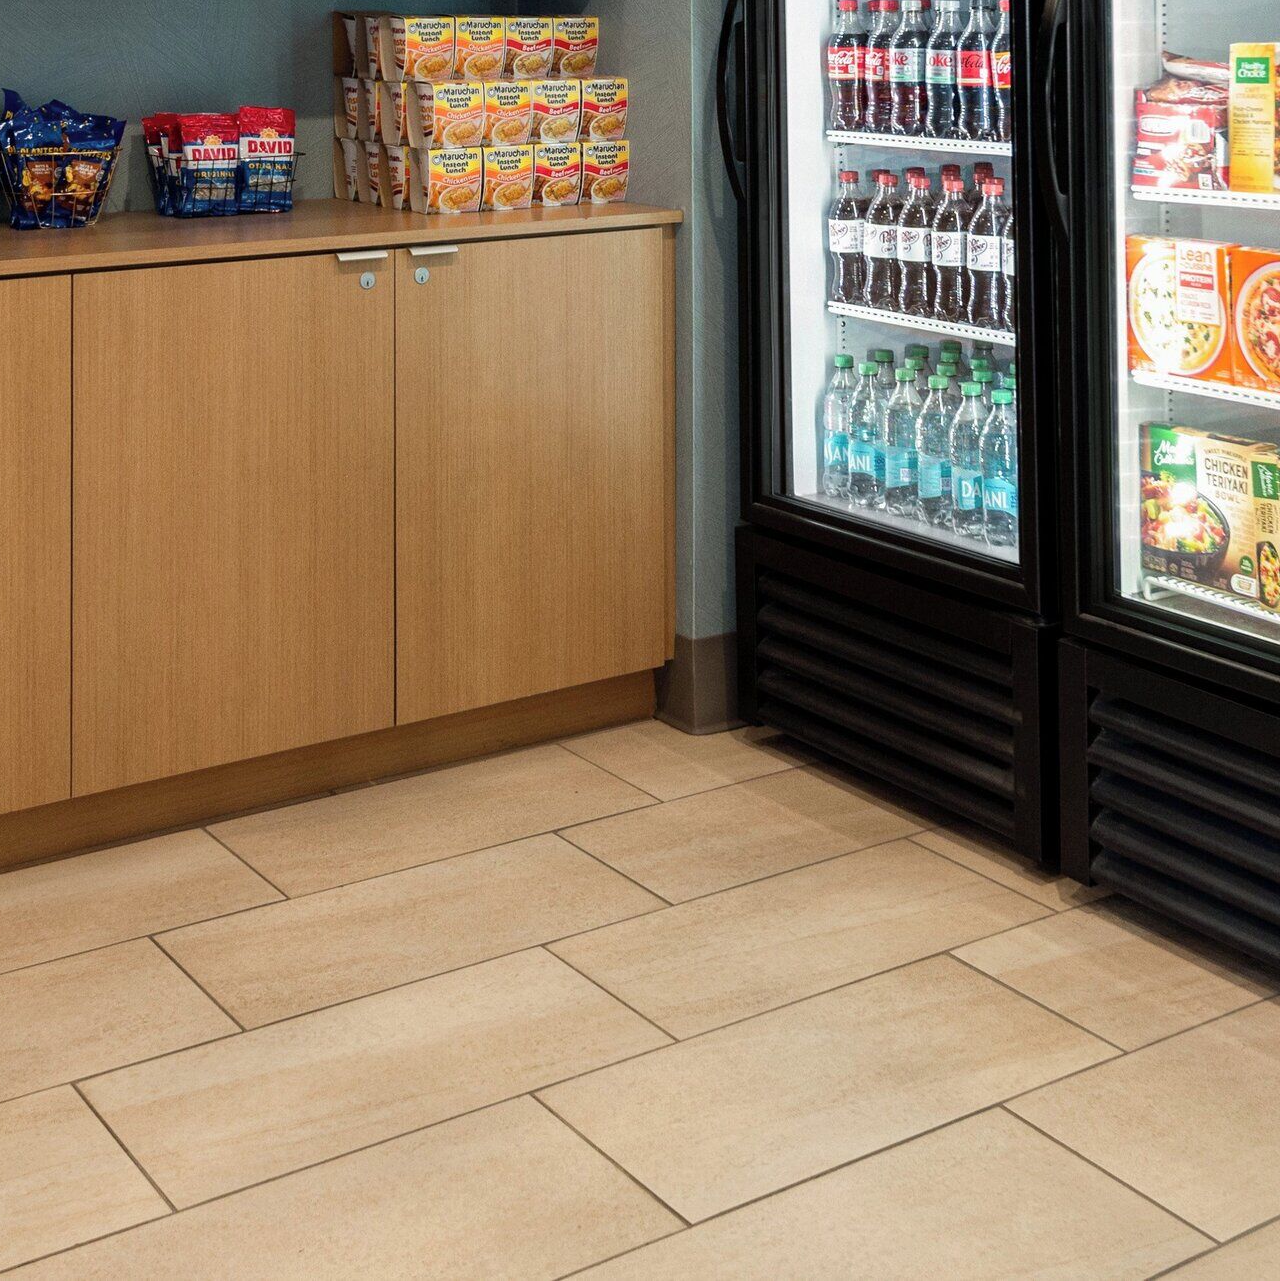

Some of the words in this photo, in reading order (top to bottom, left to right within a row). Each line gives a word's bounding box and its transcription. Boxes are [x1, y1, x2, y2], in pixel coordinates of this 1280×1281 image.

[416, 22, 450, 30] Maruchan
[522, 44, 536, 52] Beef
[1241, 62, 1266, 71] Healthy
[1238, 68, 1266, 78] Choice
[495, 86, 528, 94] Maruchan
[542, 84, 576, 92] Maruchan
[592, 83, 624, 91] Maruchan
[444, 88, 479, 96] Maruchan
[599, 106, 612, 114] Beef
[248, 140, 292, 154] DAVID
[544, 146, 577, 154] Maruchan
[594, 146, 626, 154] Maruchan
[192, 148, 236, 161] DAVID
[440, 152, 478, 160] Maruchan
[494, 150, 529, 158] Maruchan
[551, 170, 564, 178] Beef
[1180, 249, 1212, 263] Lean
[1204, 458, 1248, 479] CHICKEN
[1205, 473, 1248, 495] TERIYAKI
